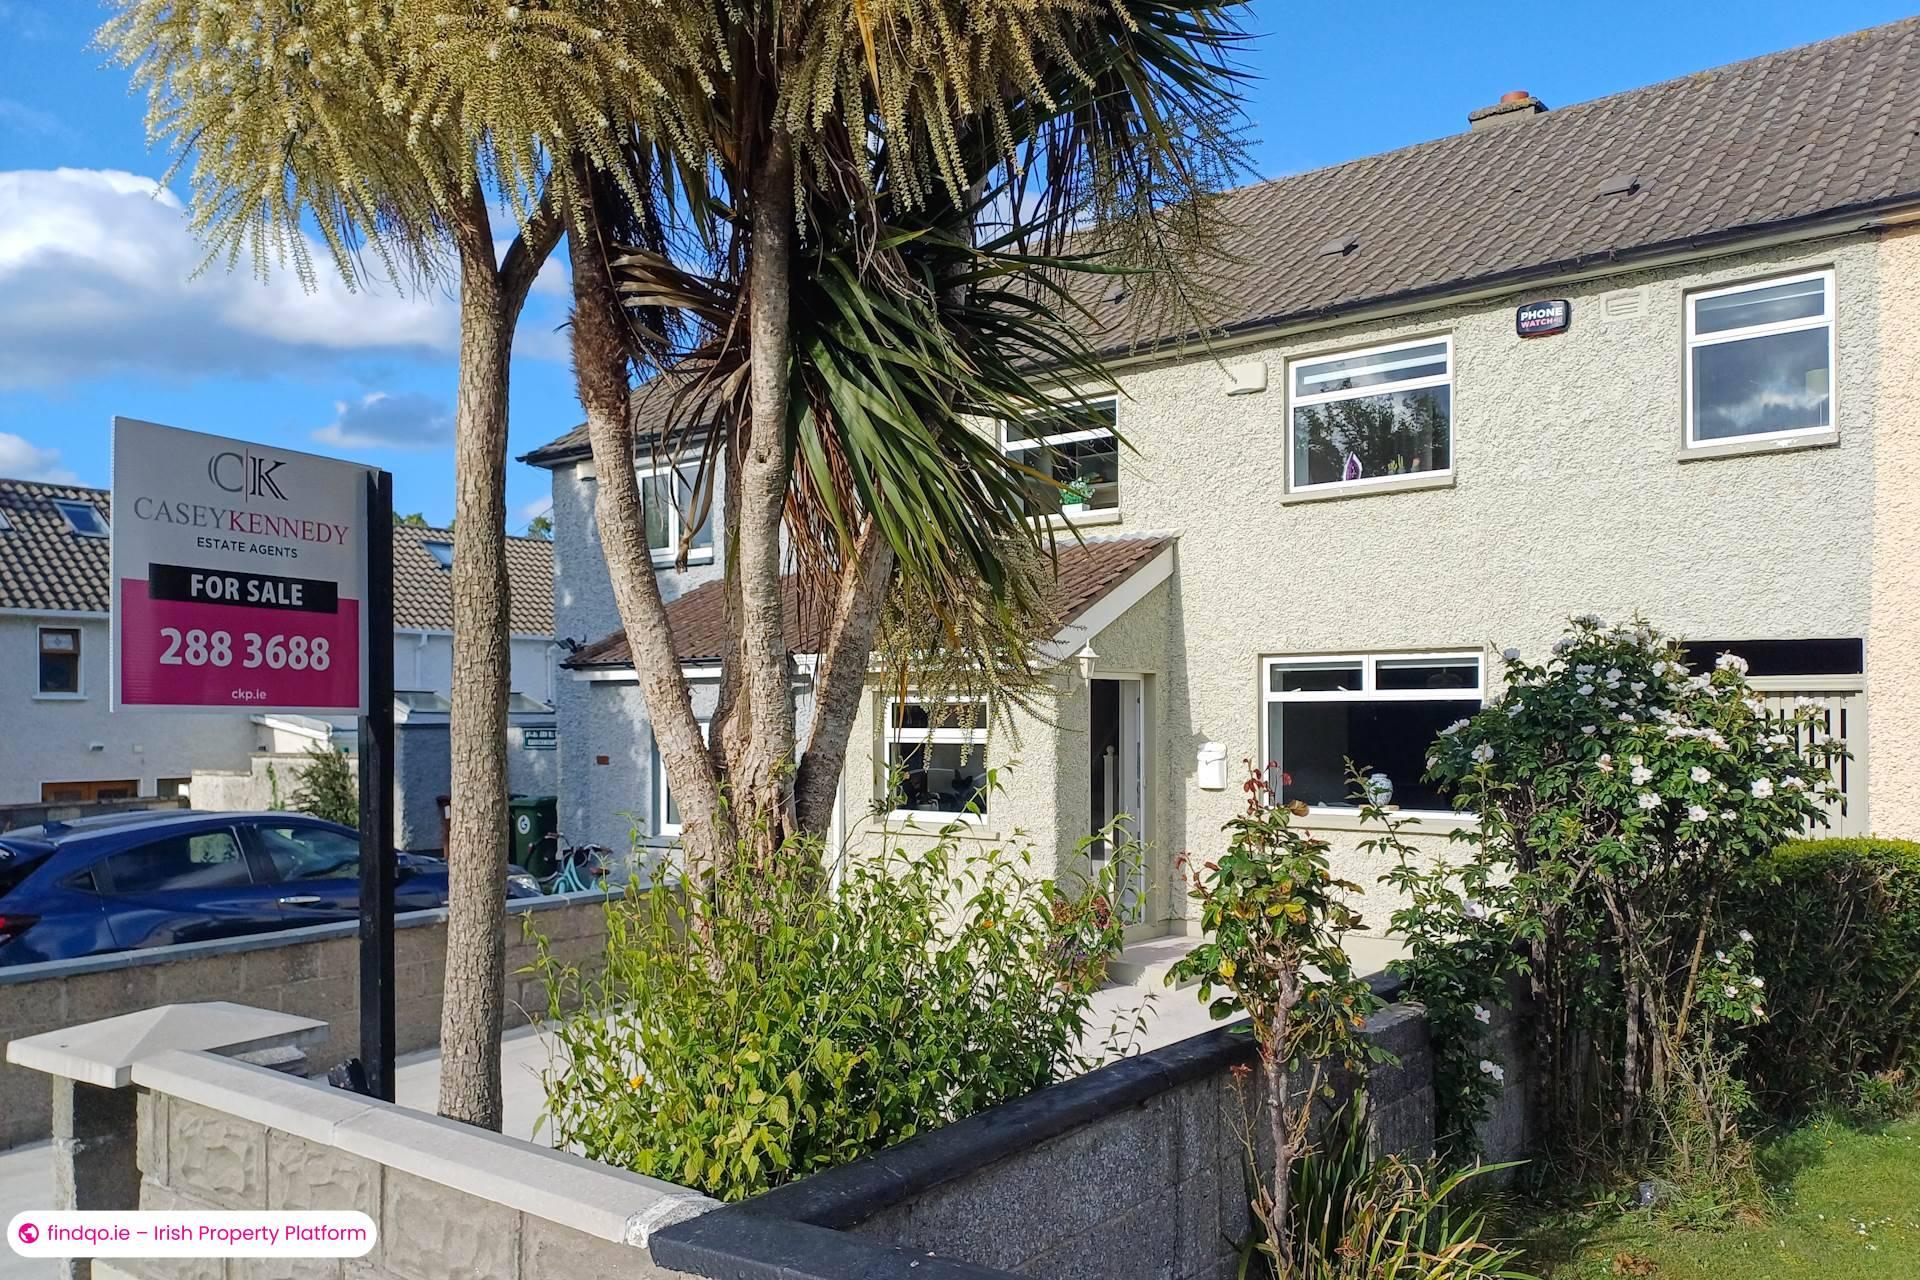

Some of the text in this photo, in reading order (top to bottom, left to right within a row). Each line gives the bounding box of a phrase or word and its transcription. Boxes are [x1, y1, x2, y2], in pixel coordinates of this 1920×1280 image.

[1520, 307, 1563, 321] PHONE
[1520, 317, 1553, 328] WATCH
[134, 497, 349, 545] CASEYKENNEDY
[197, 537, 298, 558] ESTATE AGENTS
[191, 574, 303, 606] FOR SALE
[159, 627, 330, 671] 288 3688
[231, 688, 267, 701] ckp.ie
